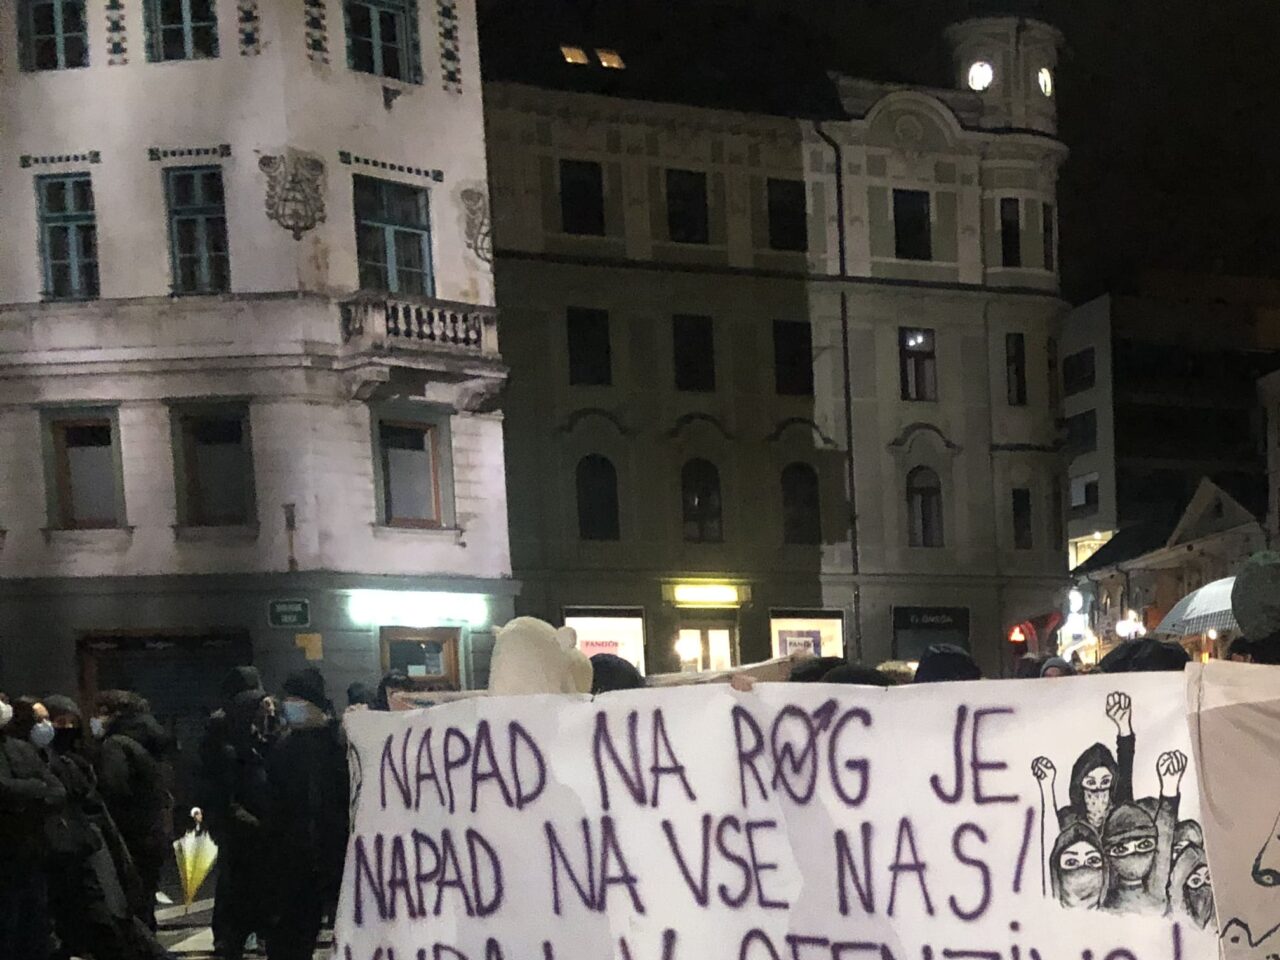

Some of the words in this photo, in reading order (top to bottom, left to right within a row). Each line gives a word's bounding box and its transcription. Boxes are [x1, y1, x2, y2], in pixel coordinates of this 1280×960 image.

[380, 719, 547, 813] NAPAD
[593, 707, 698, 811] NA
[929, 704, 1020, 805] JE
[353, 827, 504, 927] NAPAD
[544, 815, 644, 918] NA
[661, 814, 790, 909] VSE
[834, 806, 1035, 933] NAS!
